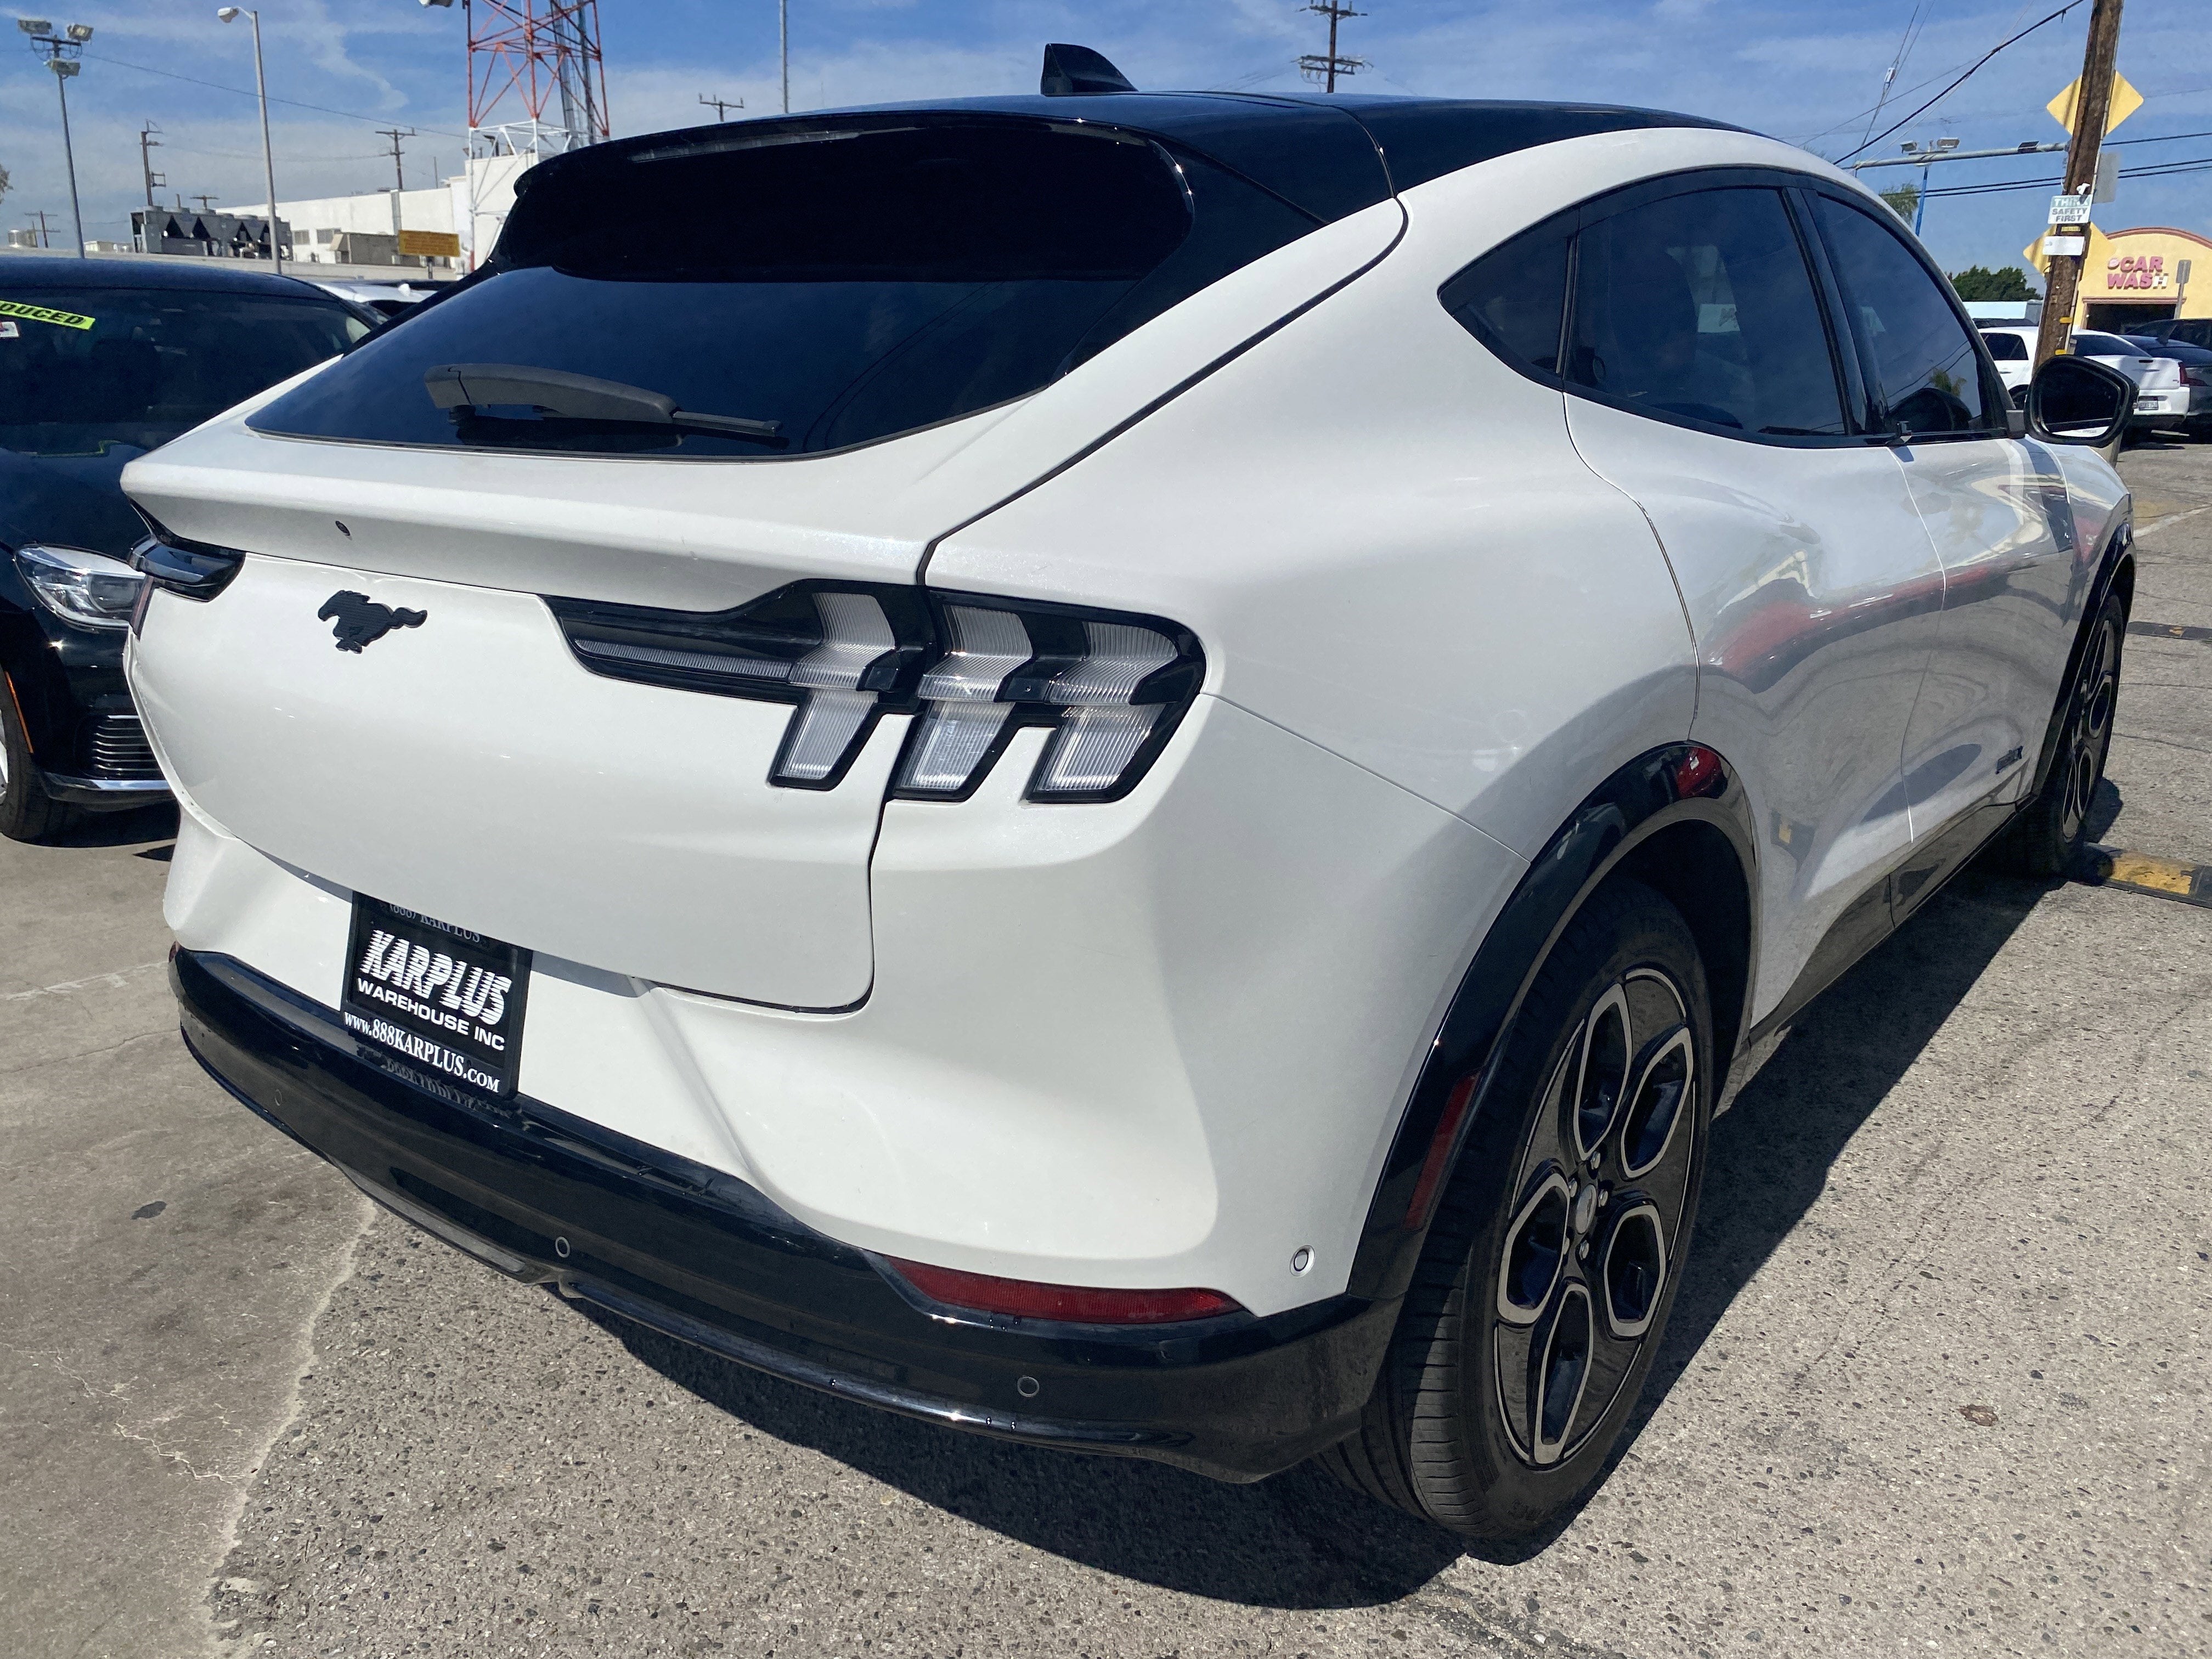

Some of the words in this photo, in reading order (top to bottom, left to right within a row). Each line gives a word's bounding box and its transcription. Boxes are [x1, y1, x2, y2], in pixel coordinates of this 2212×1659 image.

[2107, 273, 2169, 290] WASH
[2120, 256, 2163, 273] CAR
[359, 929, 512, 1025] KARPLUS
[357, 978, 470, 1036] WAREHOUSE
[474, 1026, 505, 1051] INC
